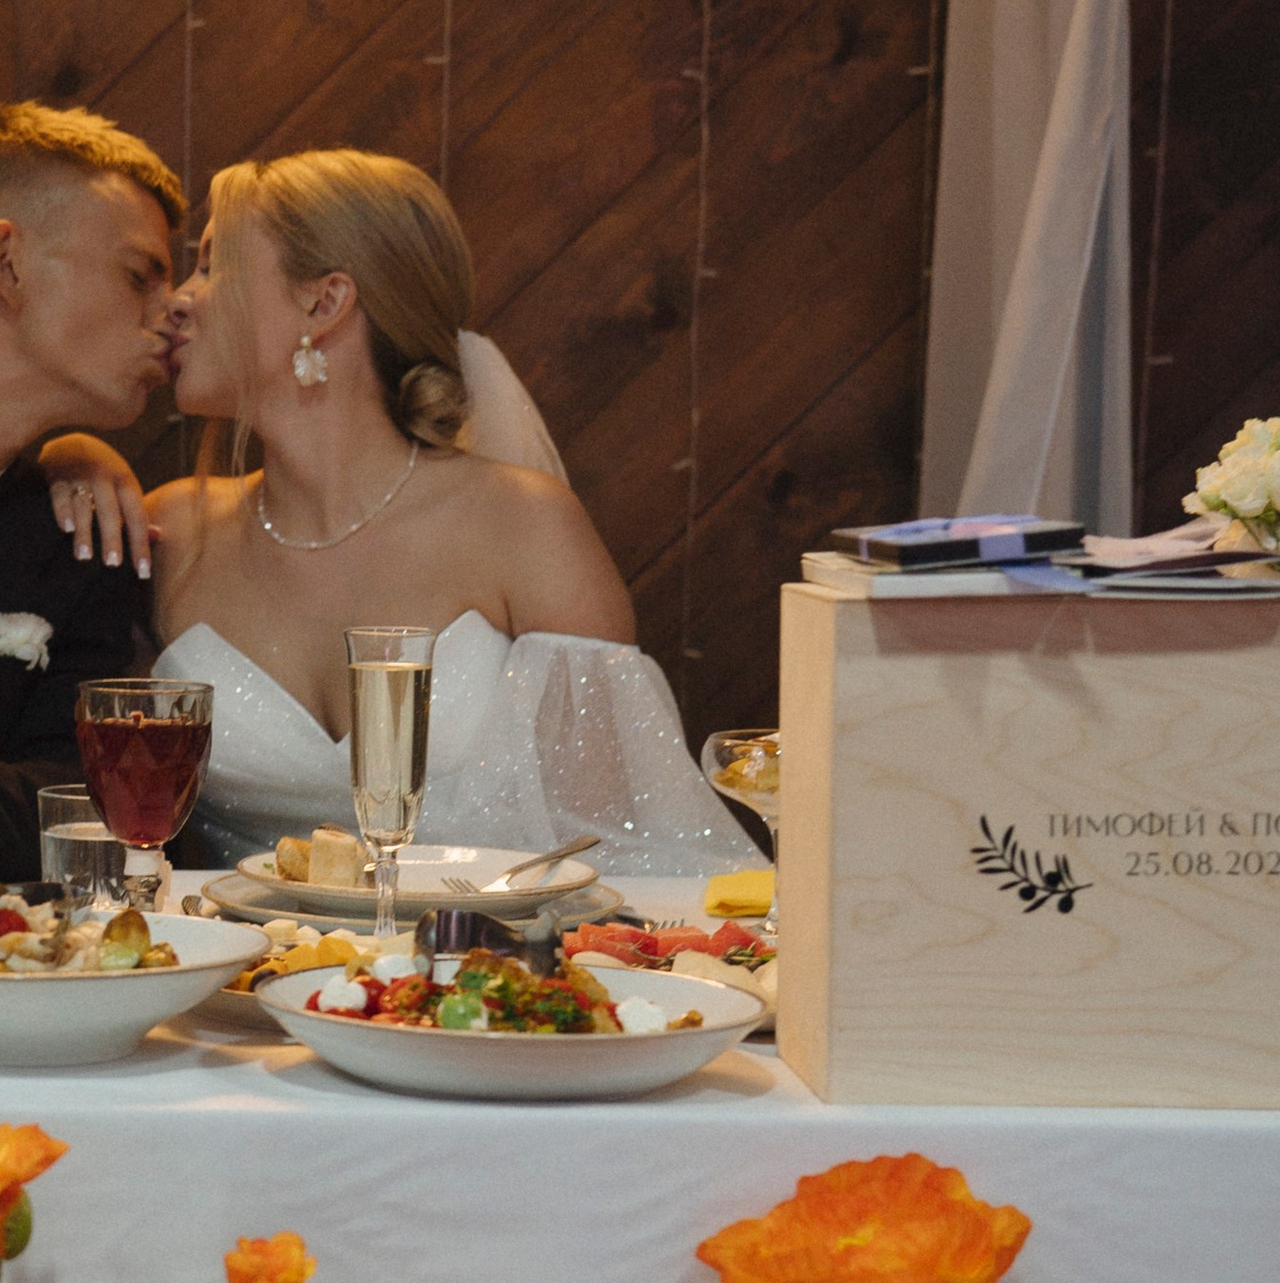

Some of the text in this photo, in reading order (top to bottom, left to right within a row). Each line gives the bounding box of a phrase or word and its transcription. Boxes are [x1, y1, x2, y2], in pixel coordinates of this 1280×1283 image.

[1048, 806, 1280, 838] ТИМОФЕЙ & П
[1125, 851, 1280, 877] 25.08.202
